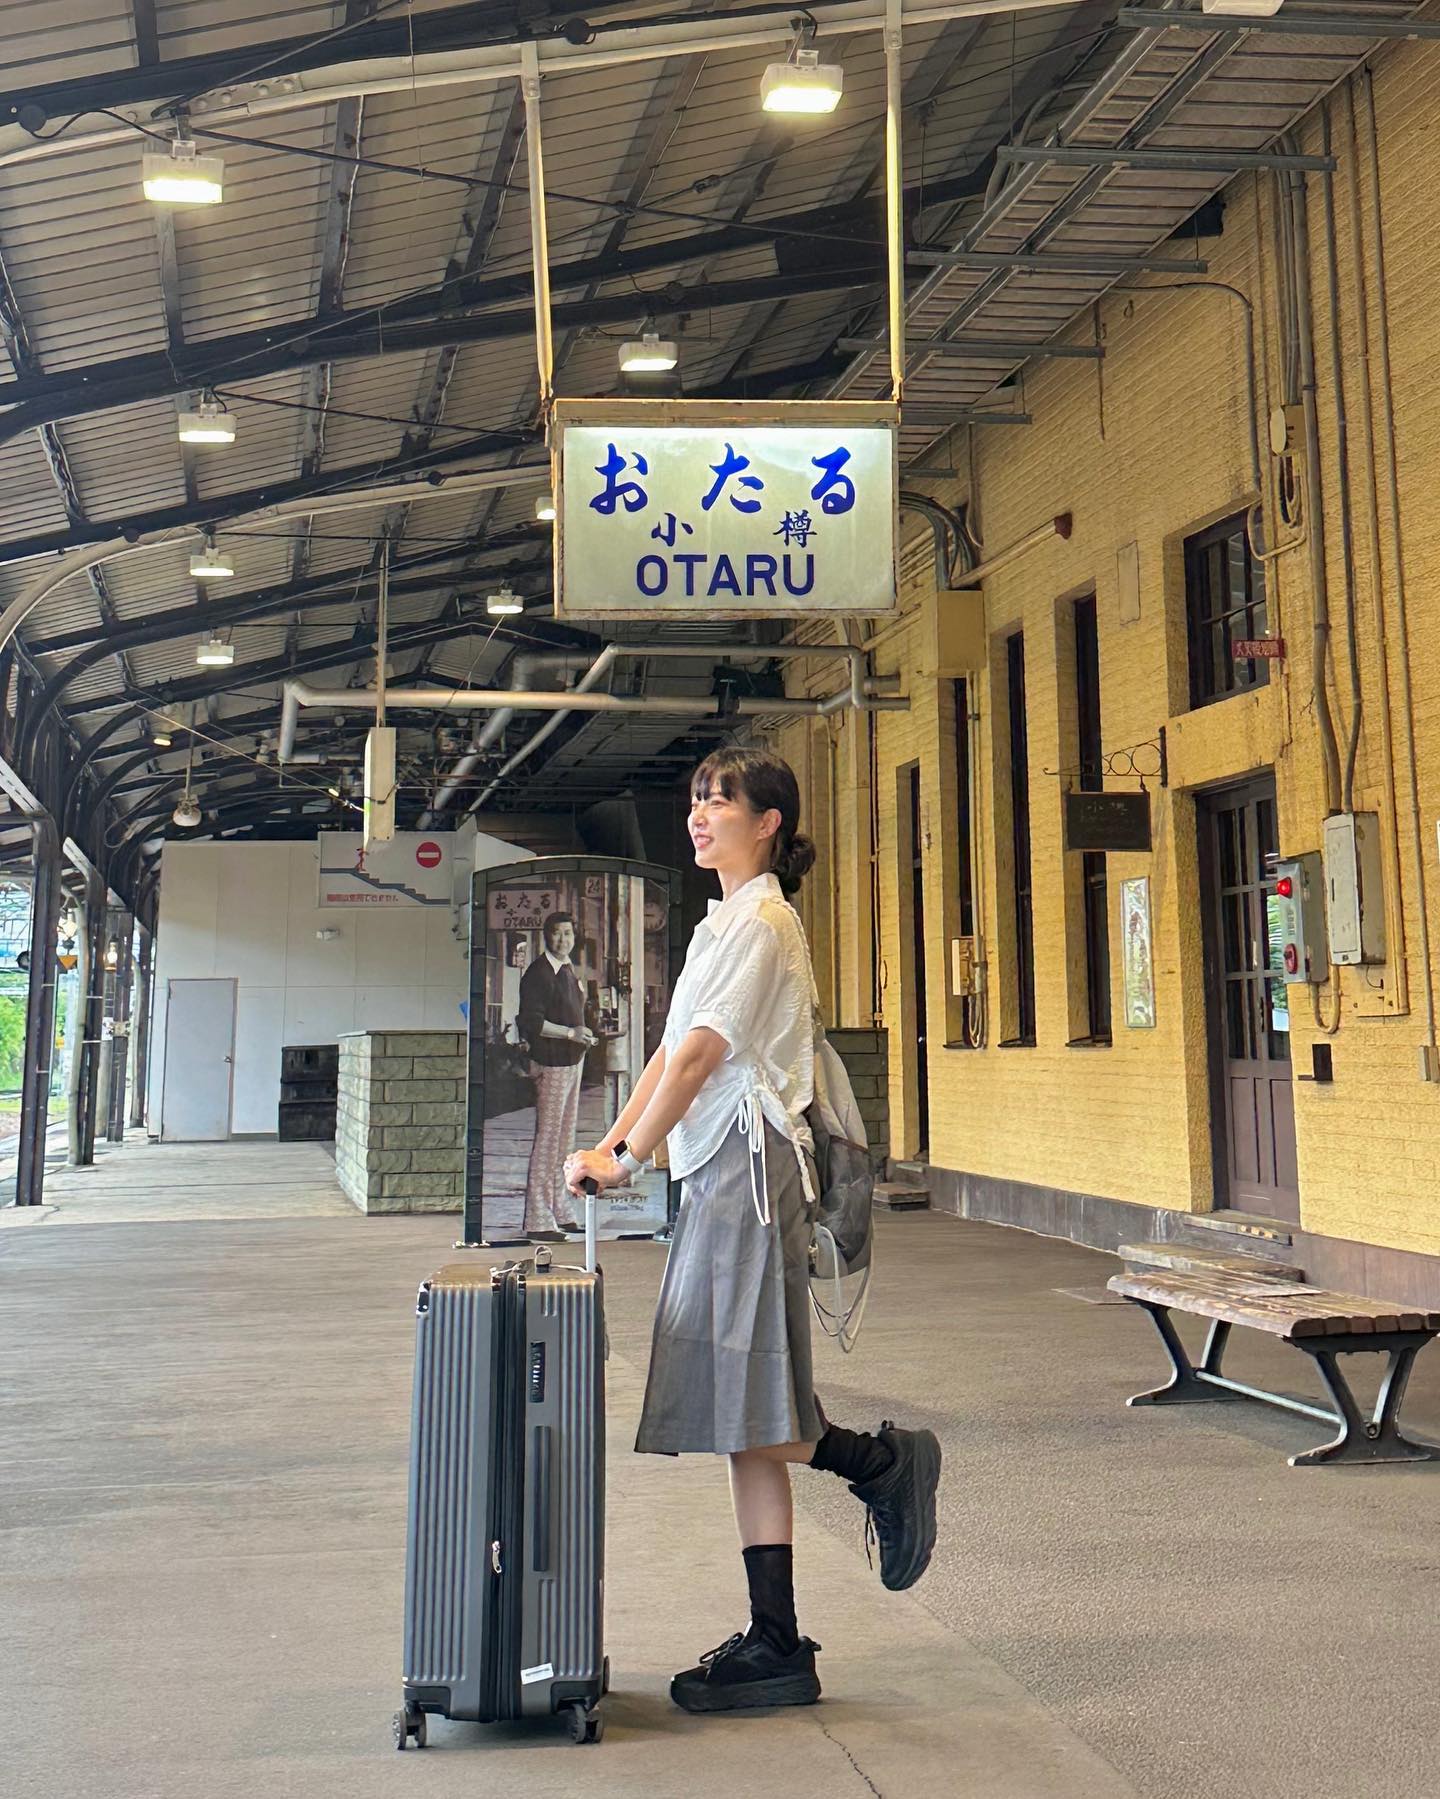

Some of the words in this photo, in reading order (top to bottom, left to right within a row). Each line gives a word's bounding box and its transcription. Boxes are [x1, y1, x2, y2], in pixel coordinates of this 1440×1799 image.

[590, 443, 855, 514] おたる
[652, 511, 817, 548] 小樽
[636, 554, 814, 596] OTARU
